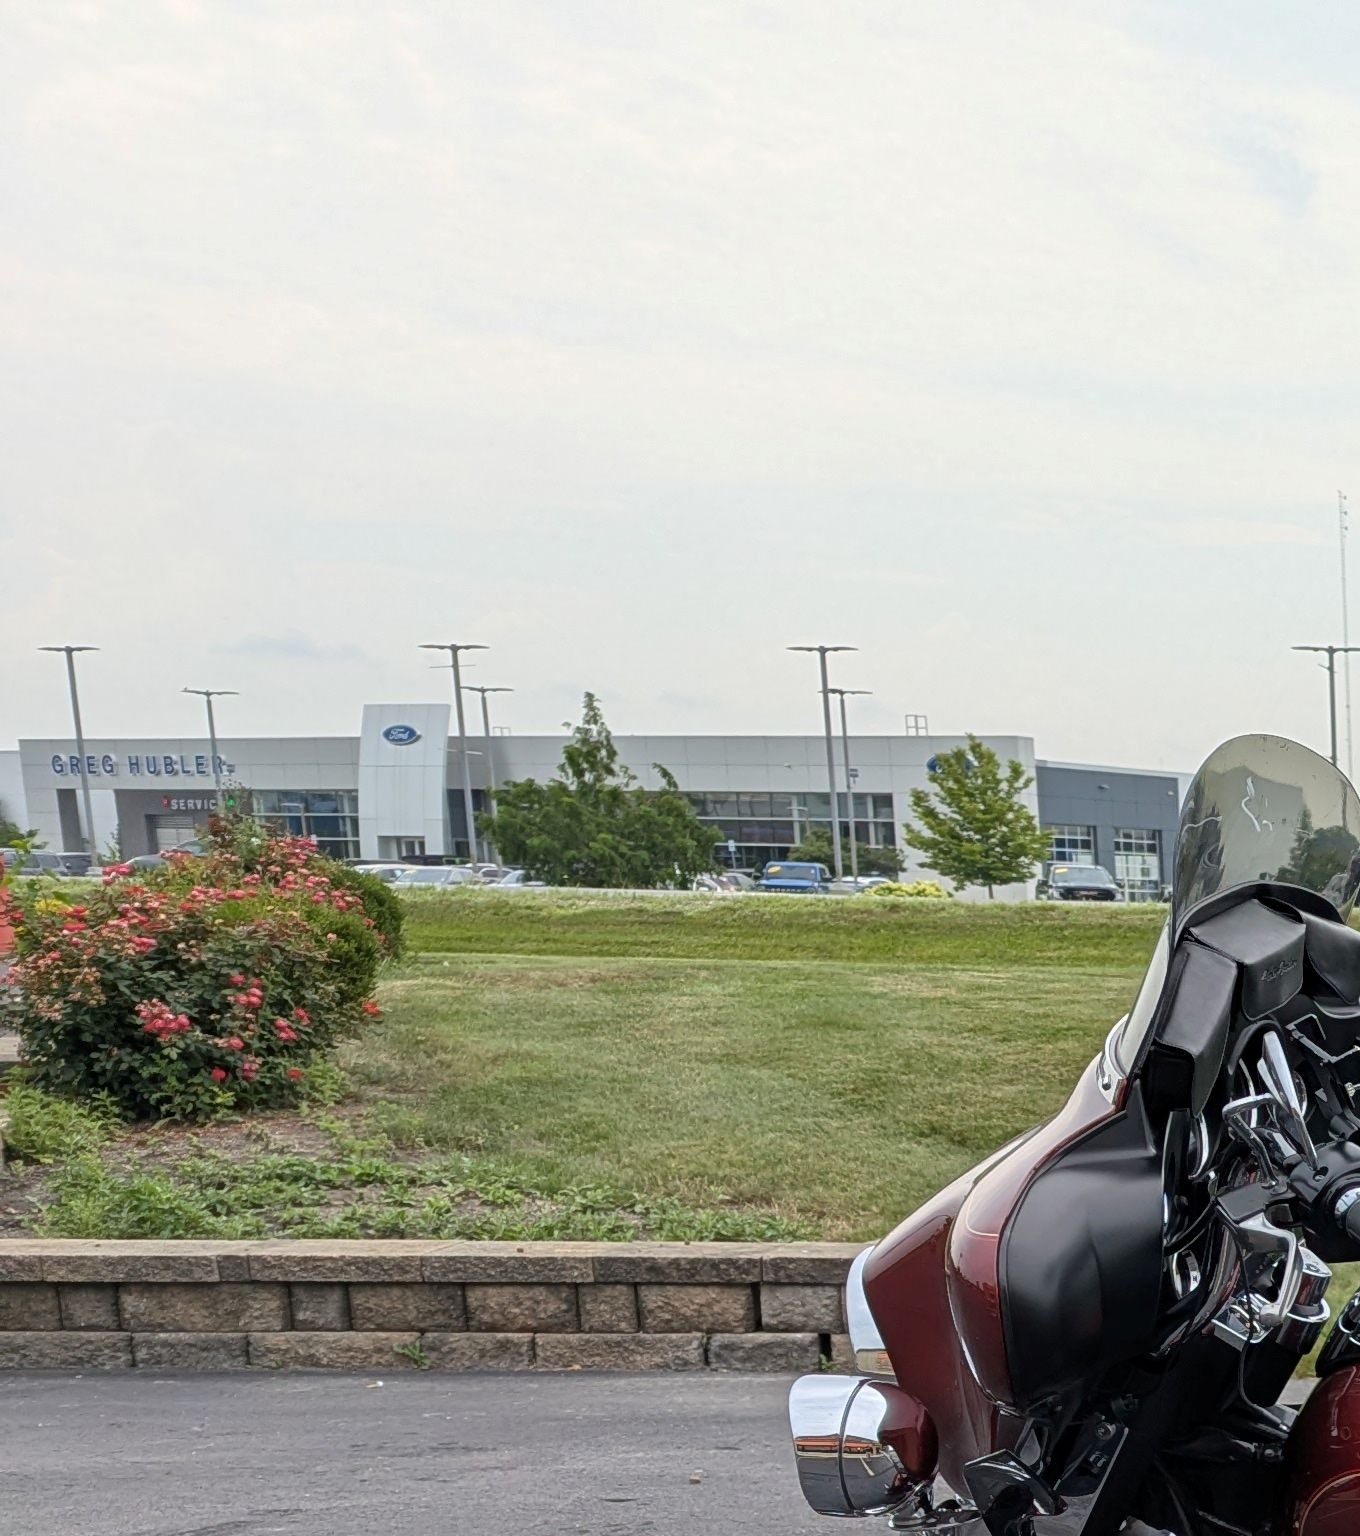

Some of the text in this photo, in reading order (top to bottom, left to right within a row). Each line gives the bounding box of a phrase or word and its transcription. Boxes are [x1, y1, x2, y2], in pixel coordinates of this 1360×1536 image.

[52, 755, 225, 776] GREG HUBLER
[171, 799, 222, 810] SERVIC
